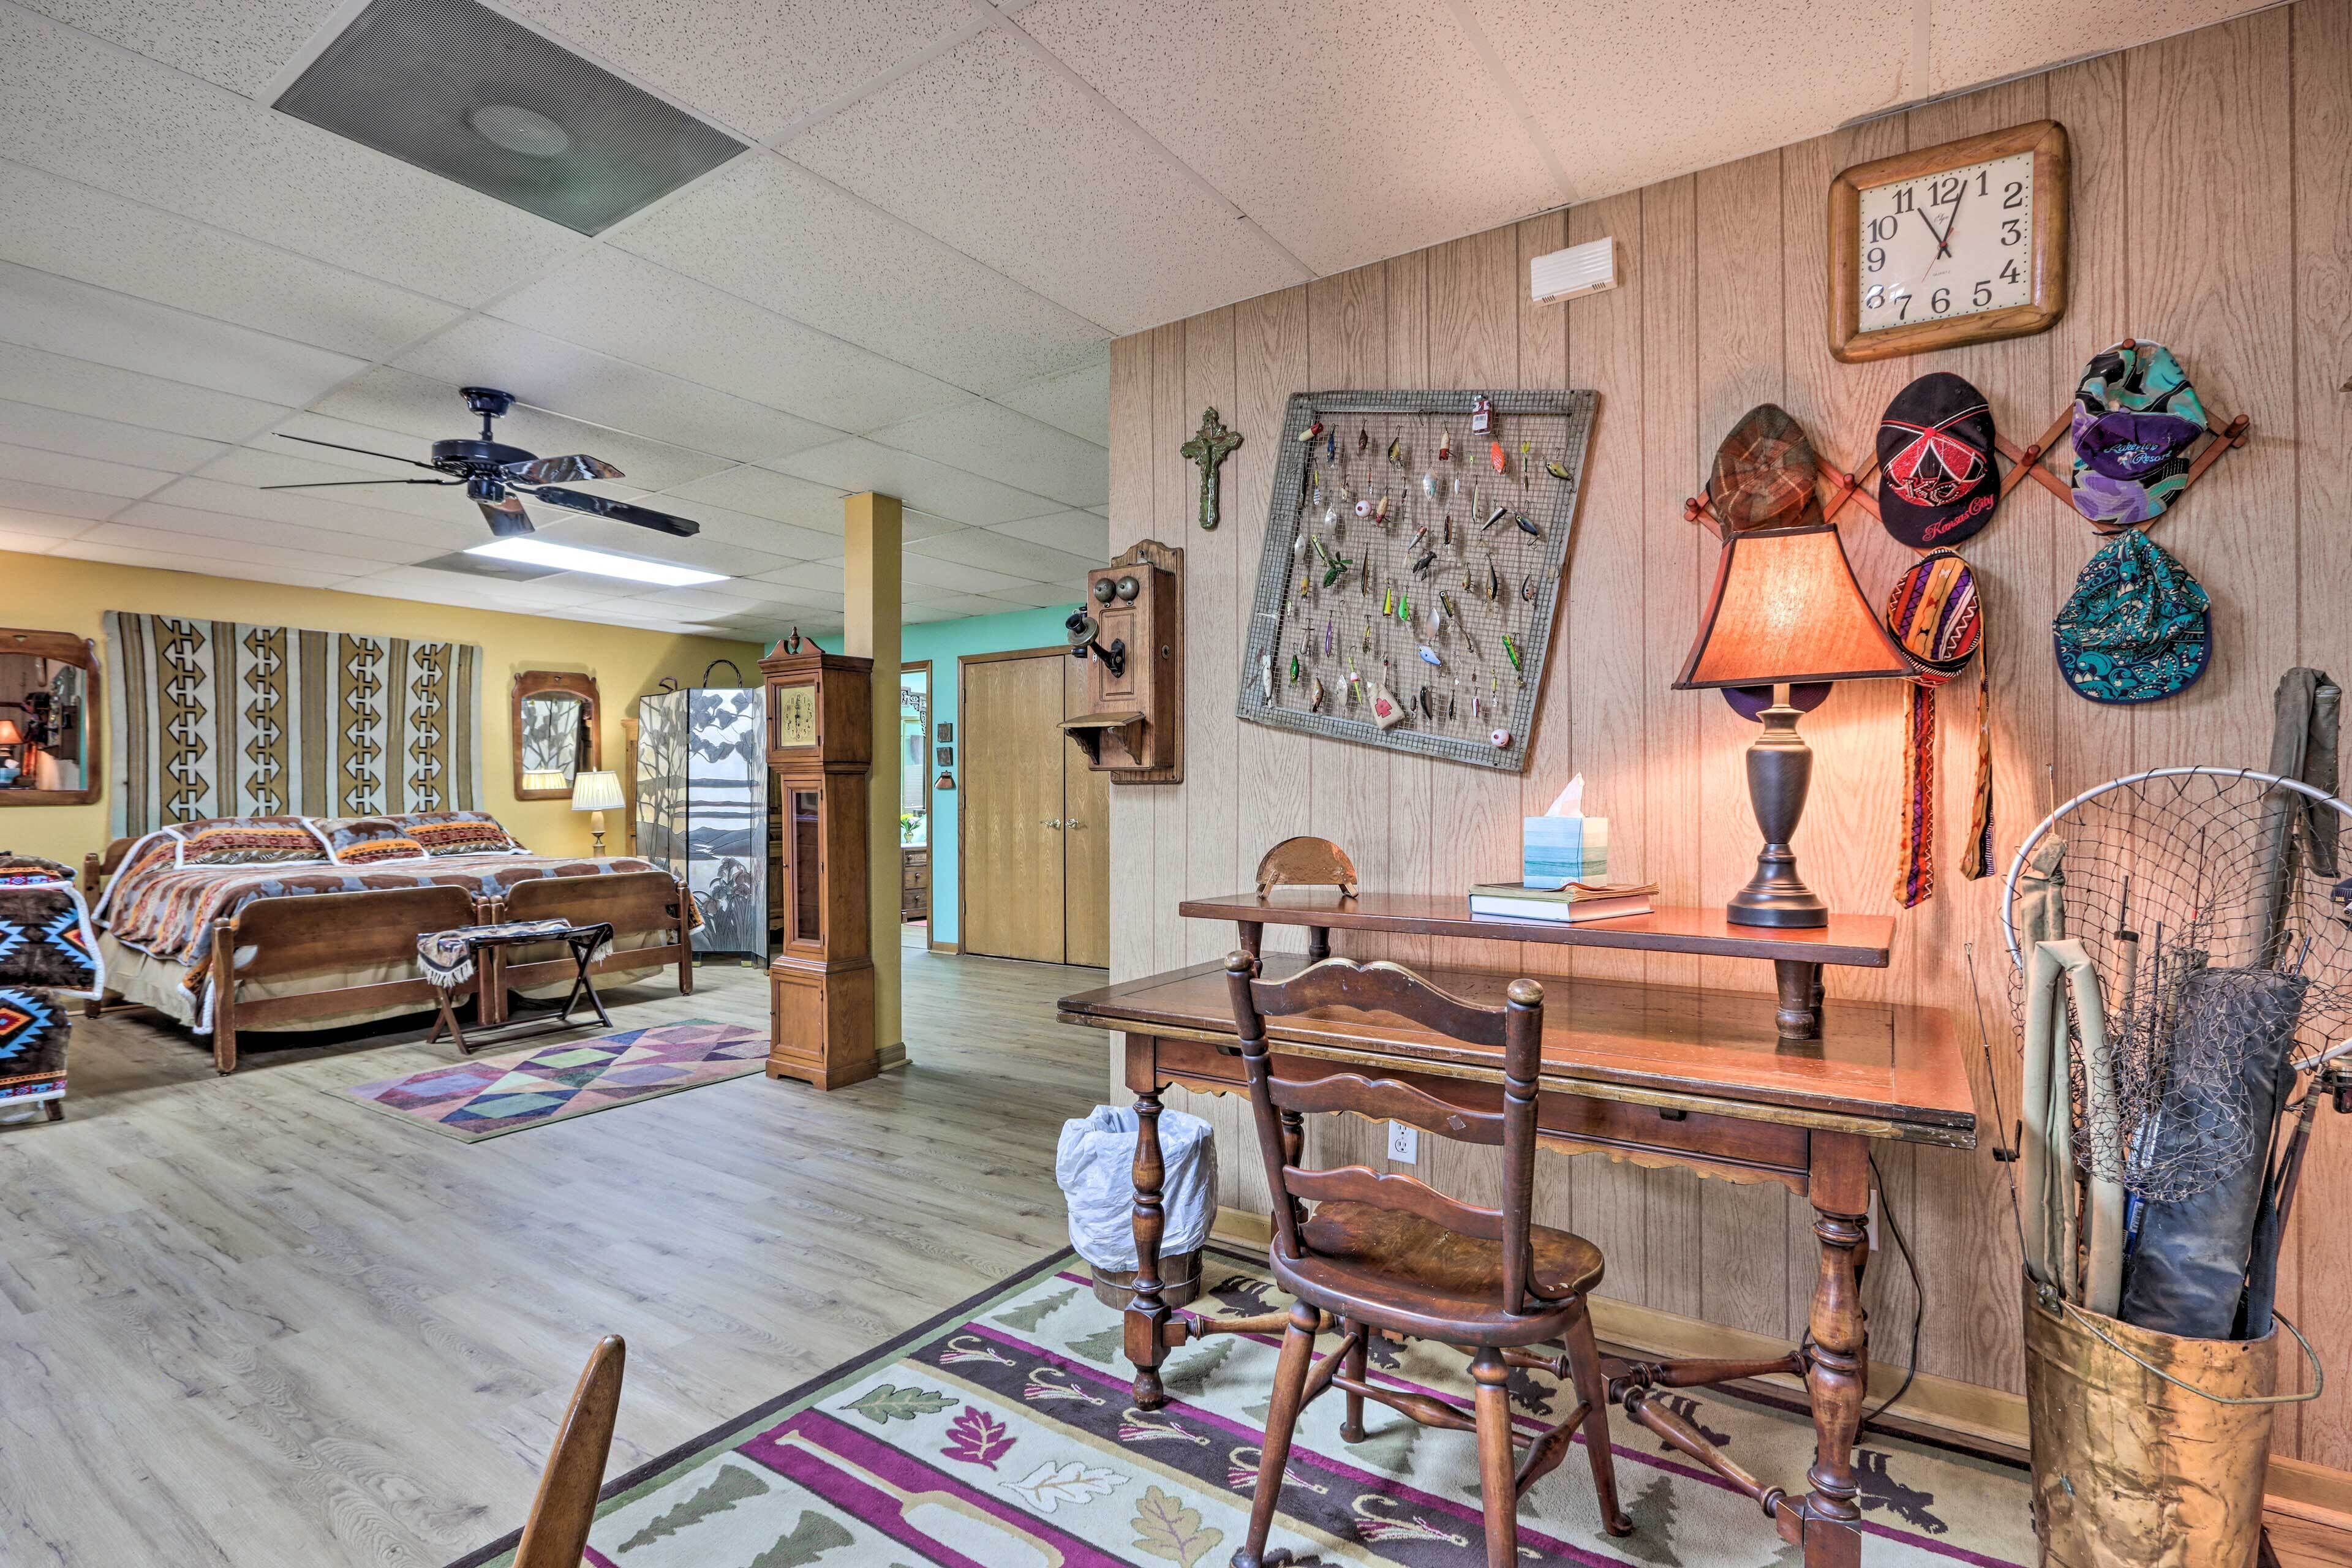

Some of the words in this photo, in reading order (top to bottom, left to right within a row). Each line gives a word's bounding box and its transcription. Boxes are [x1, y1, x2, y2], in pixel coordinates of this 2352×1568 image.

[1928, 178, 1959, 207] 12
[1975, 170, 1988, 197] 1
[2003, 181, 2022, 209] 2
[1892, 187, 1914, 214] 11
[1868, 216, 1898, 243] 10
[2000, 219, 2021, 246] 3
[1868, 247, 1885, 272] 9
[1999, 258, 2021, 284] 4
[1866, 284, 1885, 309] 8
[1931, 288, 1950, 314] 6
[1972, 280, 1992, 306] 5
[1894, 294, 1912, 320] 7
[2132, 450, 2172, 464] Resort
[1922, 511, 1969, 541] Kansas
[1969, 494, 1994, 515] City
